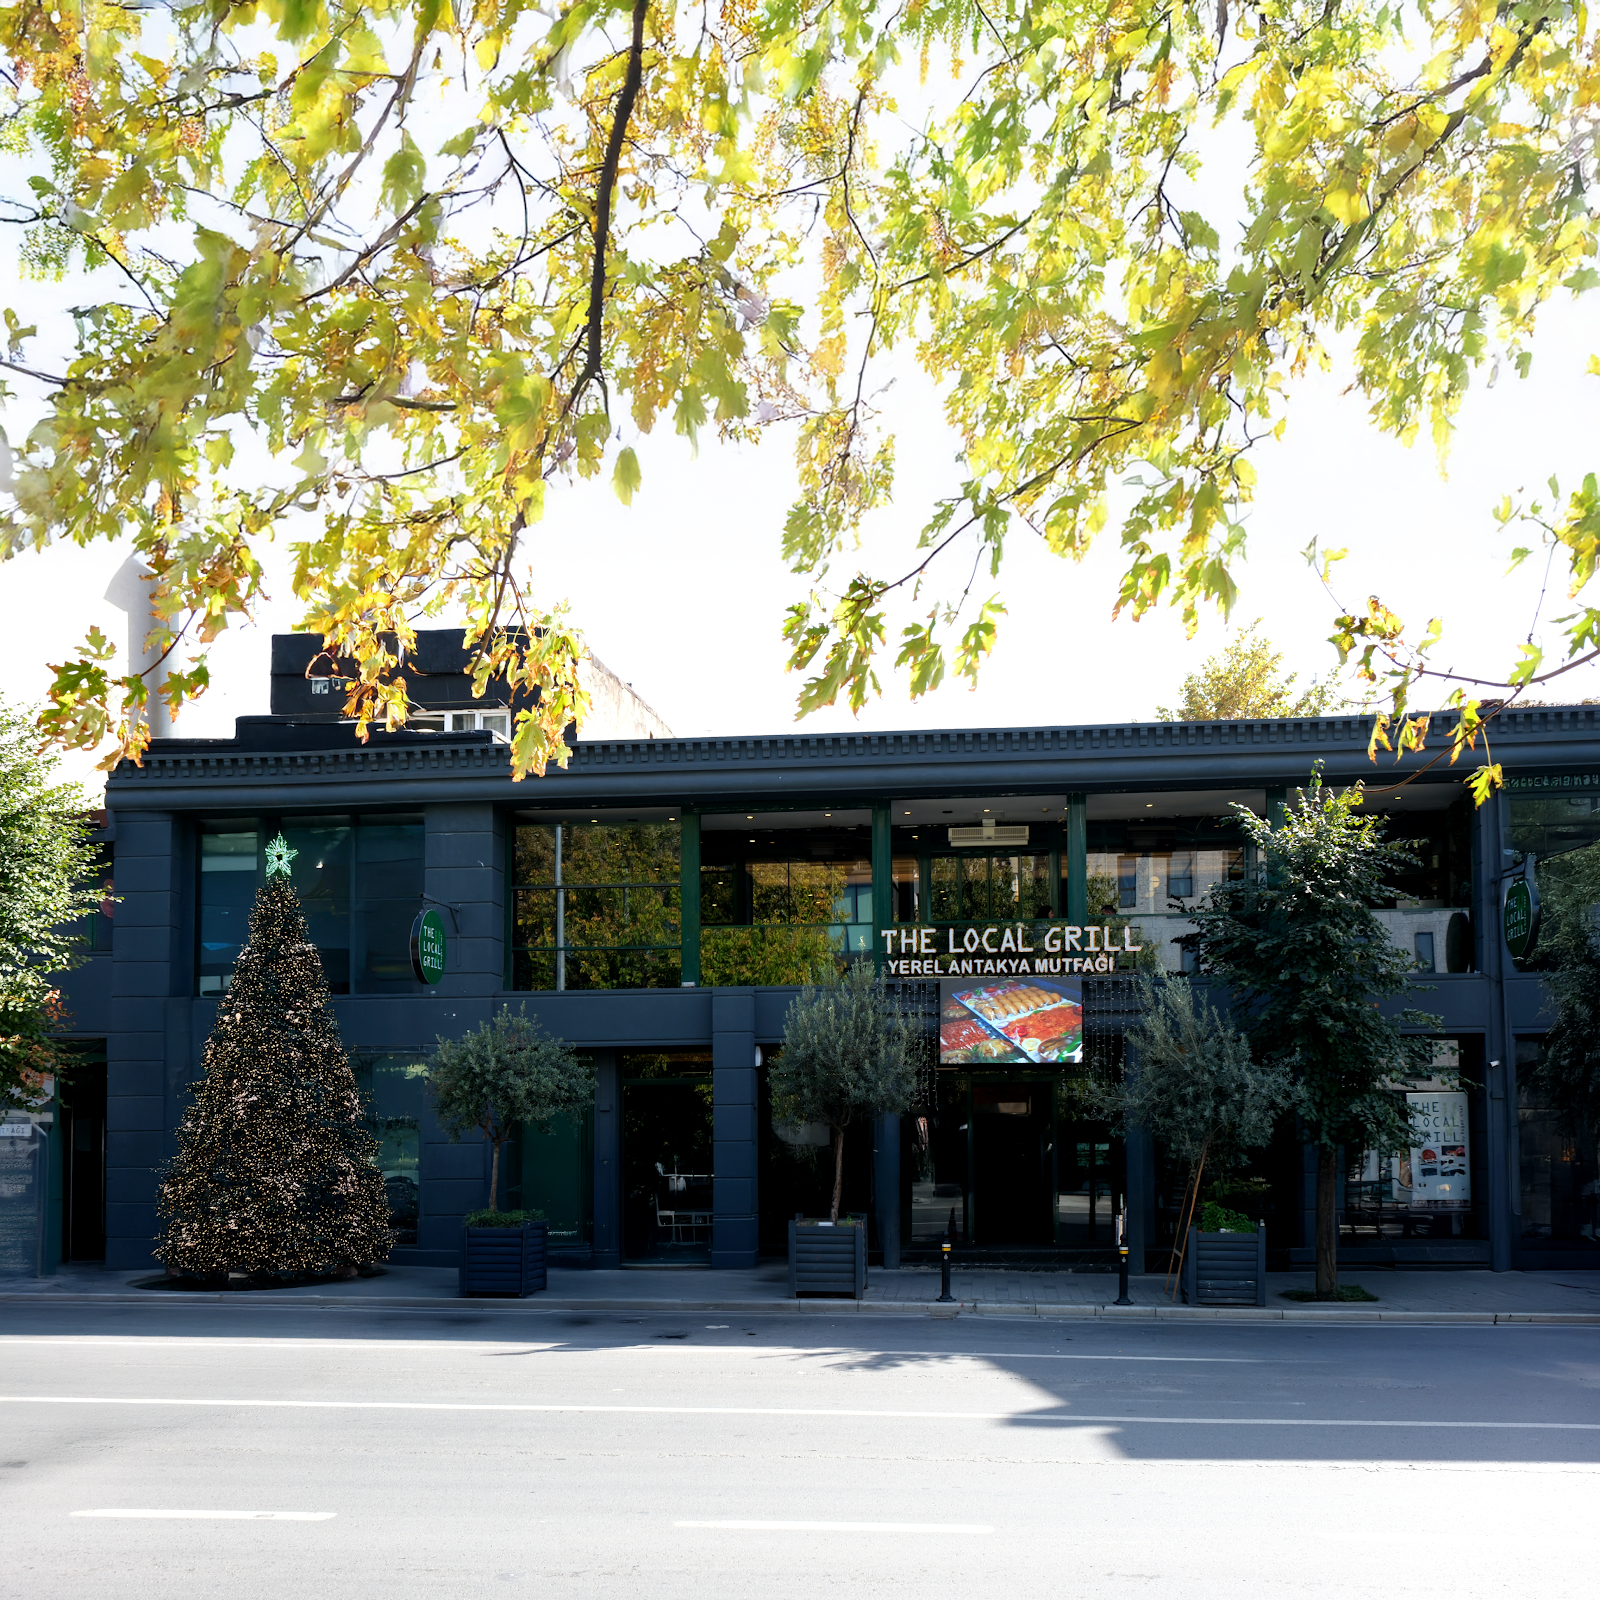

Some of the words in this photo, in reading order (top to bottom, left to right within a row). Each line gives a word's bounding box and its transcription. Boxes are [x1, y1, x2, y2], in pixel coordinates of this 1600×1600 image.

[1507, 896, 1517, 911] THE
[1506, 909, 1524, 926] LOCAL
[423, 925, 435, 939] THE
[881, 928, 937, 954] THE
[949, 927, 1034, 953] LOCAL
[1044, 925, 1142, 953] GRILL
[1506, 924, 1525, 941] GRILL
[423, 941, 441, 955] LOCAL
[423, 955, 442, 970] GRILL
[887, 959, 944, 975] YEREL
[949, 958, 1031, 974] ANTAKYA
[1034, 953, 1115, 974] MUTFAĞI
[1411, 1101, 1439, 1113] THE
[1412, 1116, 1459, 1128] LOCAL
